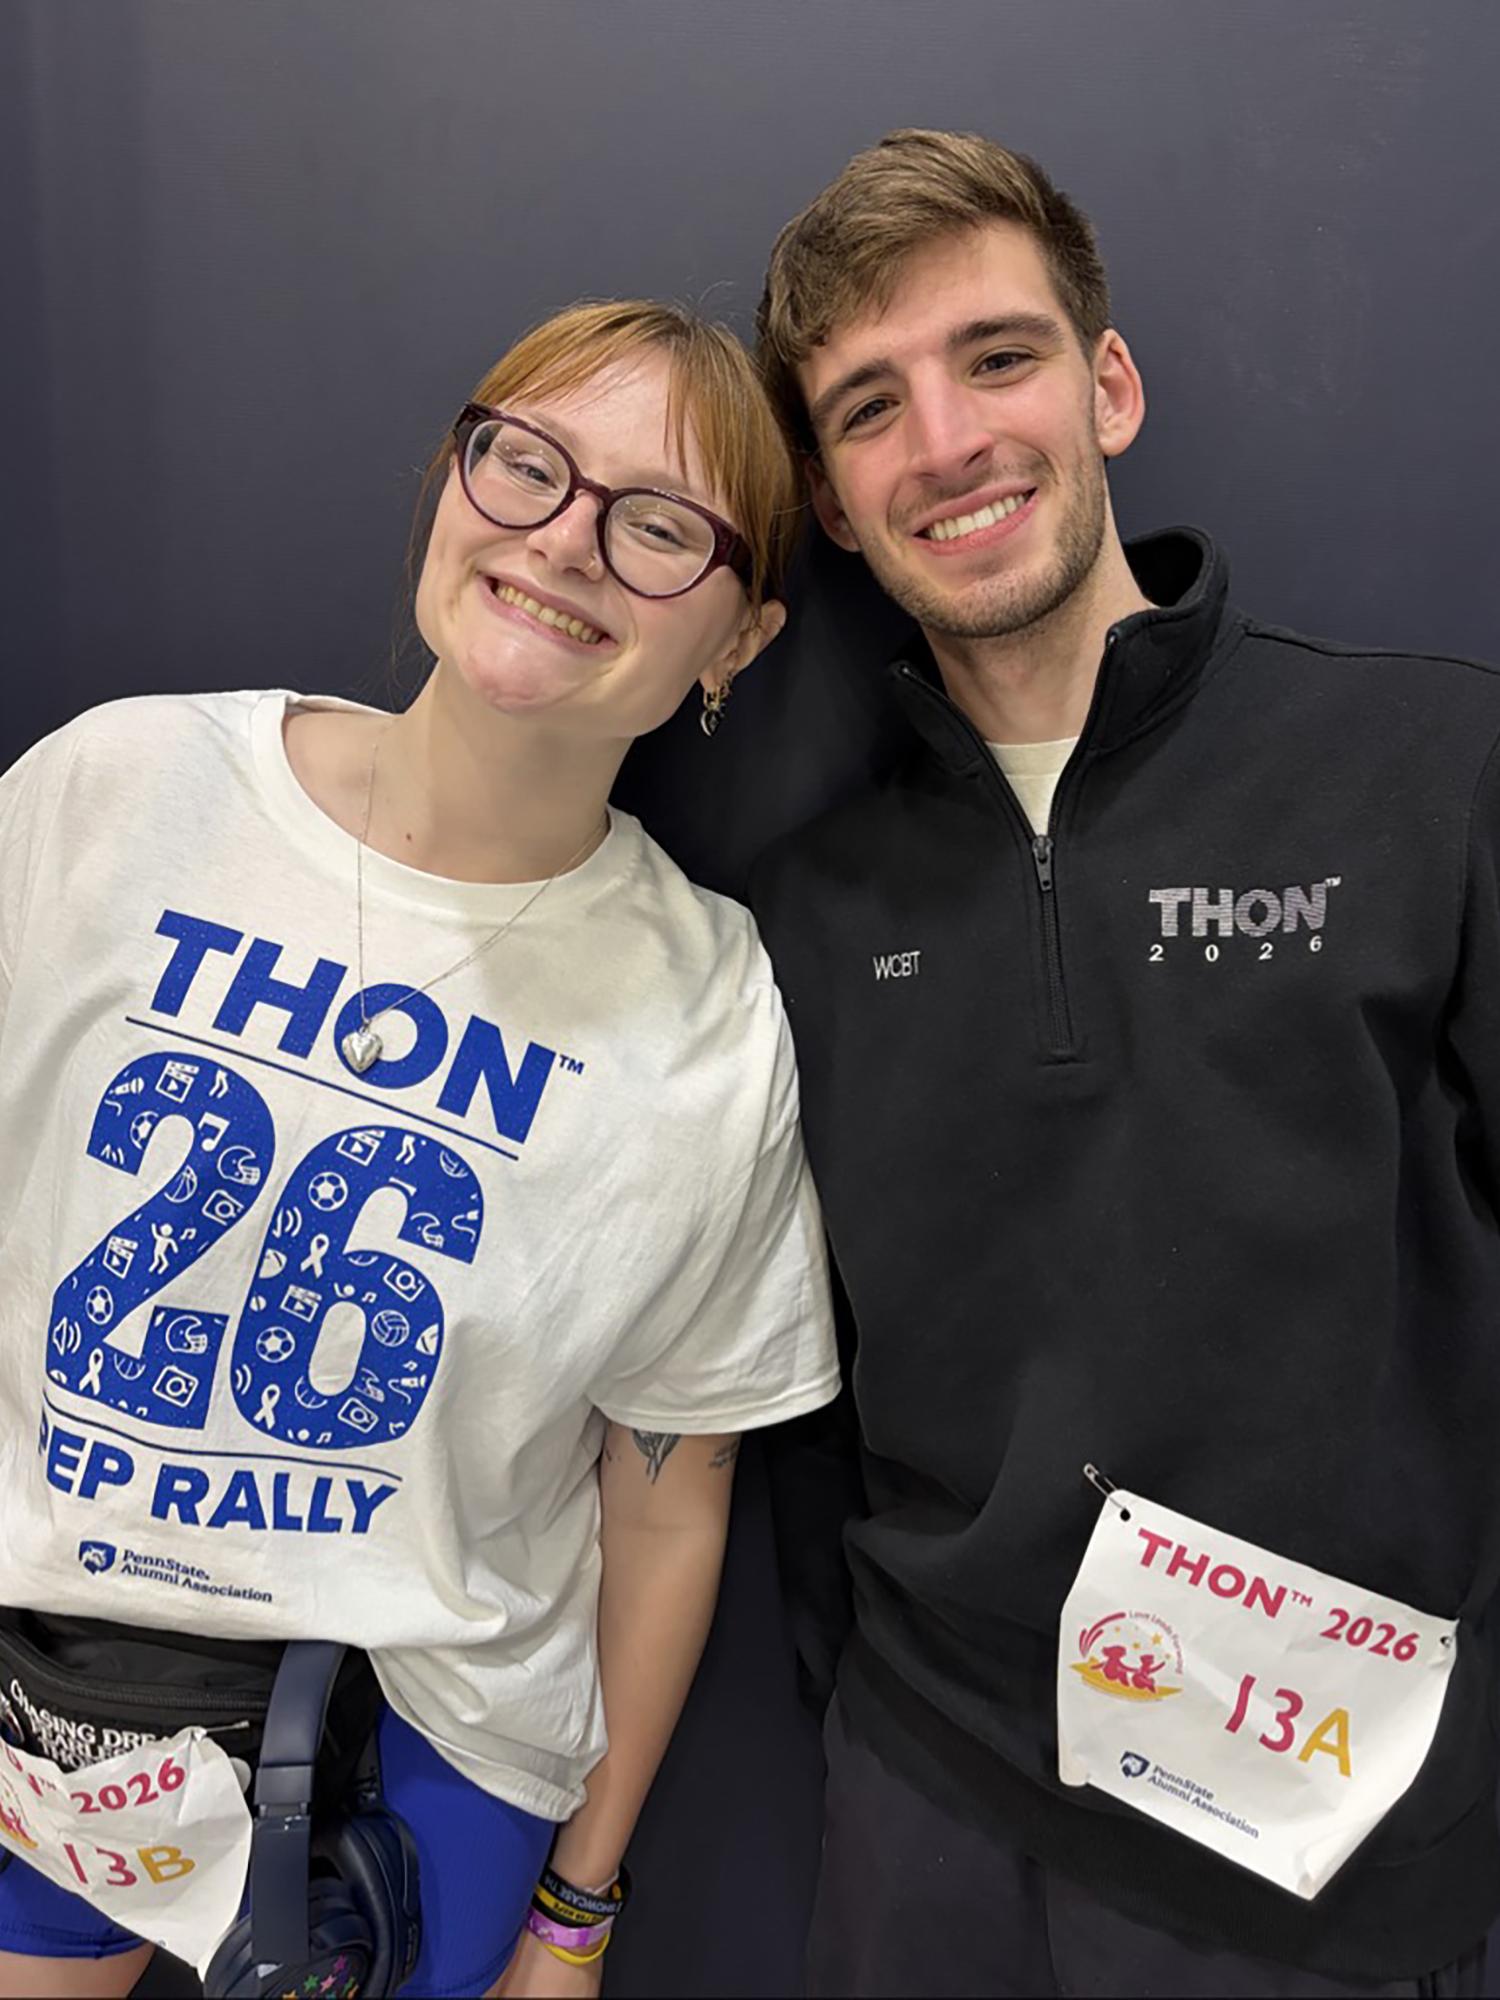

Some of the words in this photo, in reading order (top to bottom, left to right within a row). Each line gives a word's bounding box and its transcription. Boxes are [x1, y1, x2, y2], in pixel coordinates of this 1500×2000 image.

[872, 950, 921, 980] WCBT
[46, 1051, 485, 1450] 26
[150, 1463, 399, 1535] RALLY
[121, 1564, 179, 1586] Alumni
[181, 1577, 273, 1603] Association
[1320, 1608, 1419, 1663] 2026
[1223, 1674, 1352, 1777] 13A
[70, 1756, 186, 1814] 2026
[1147, 1775, 1192, 1802] Alumni
[1190, 1795, 1259, 1839] Association
[1152, 1765, 1214, 1801] PennState
[64, 1843, 195, 1886] 13B
